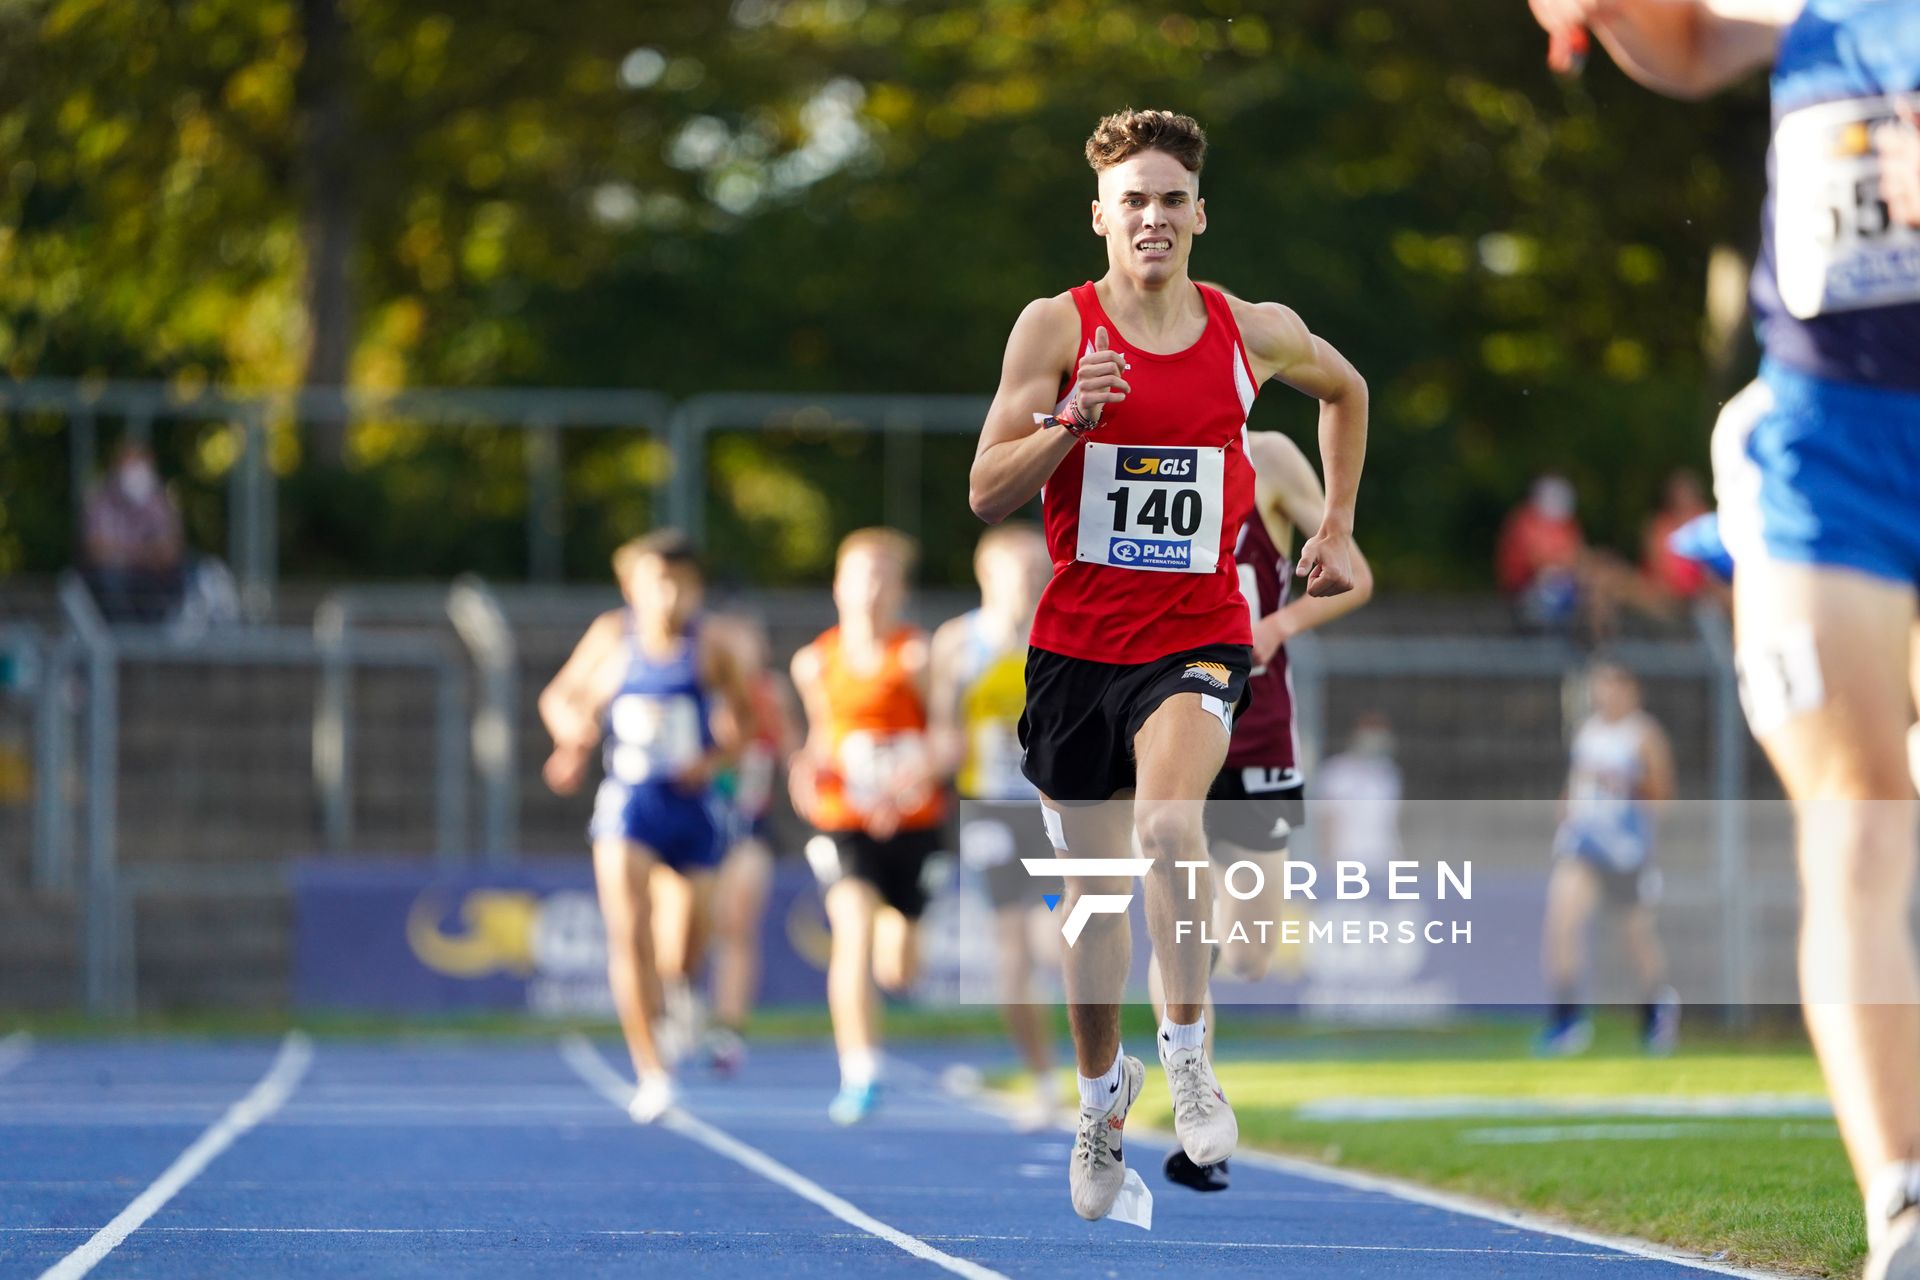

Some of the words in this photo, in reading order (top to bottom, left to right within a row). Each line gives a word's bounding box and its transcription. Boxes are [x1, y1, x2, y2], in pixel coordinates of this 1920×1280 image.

[1159, 458, 1191, 476] GLS
[1107, 487, 1203, 536] 140
[1143, 544, 1188, 559] PLAN
